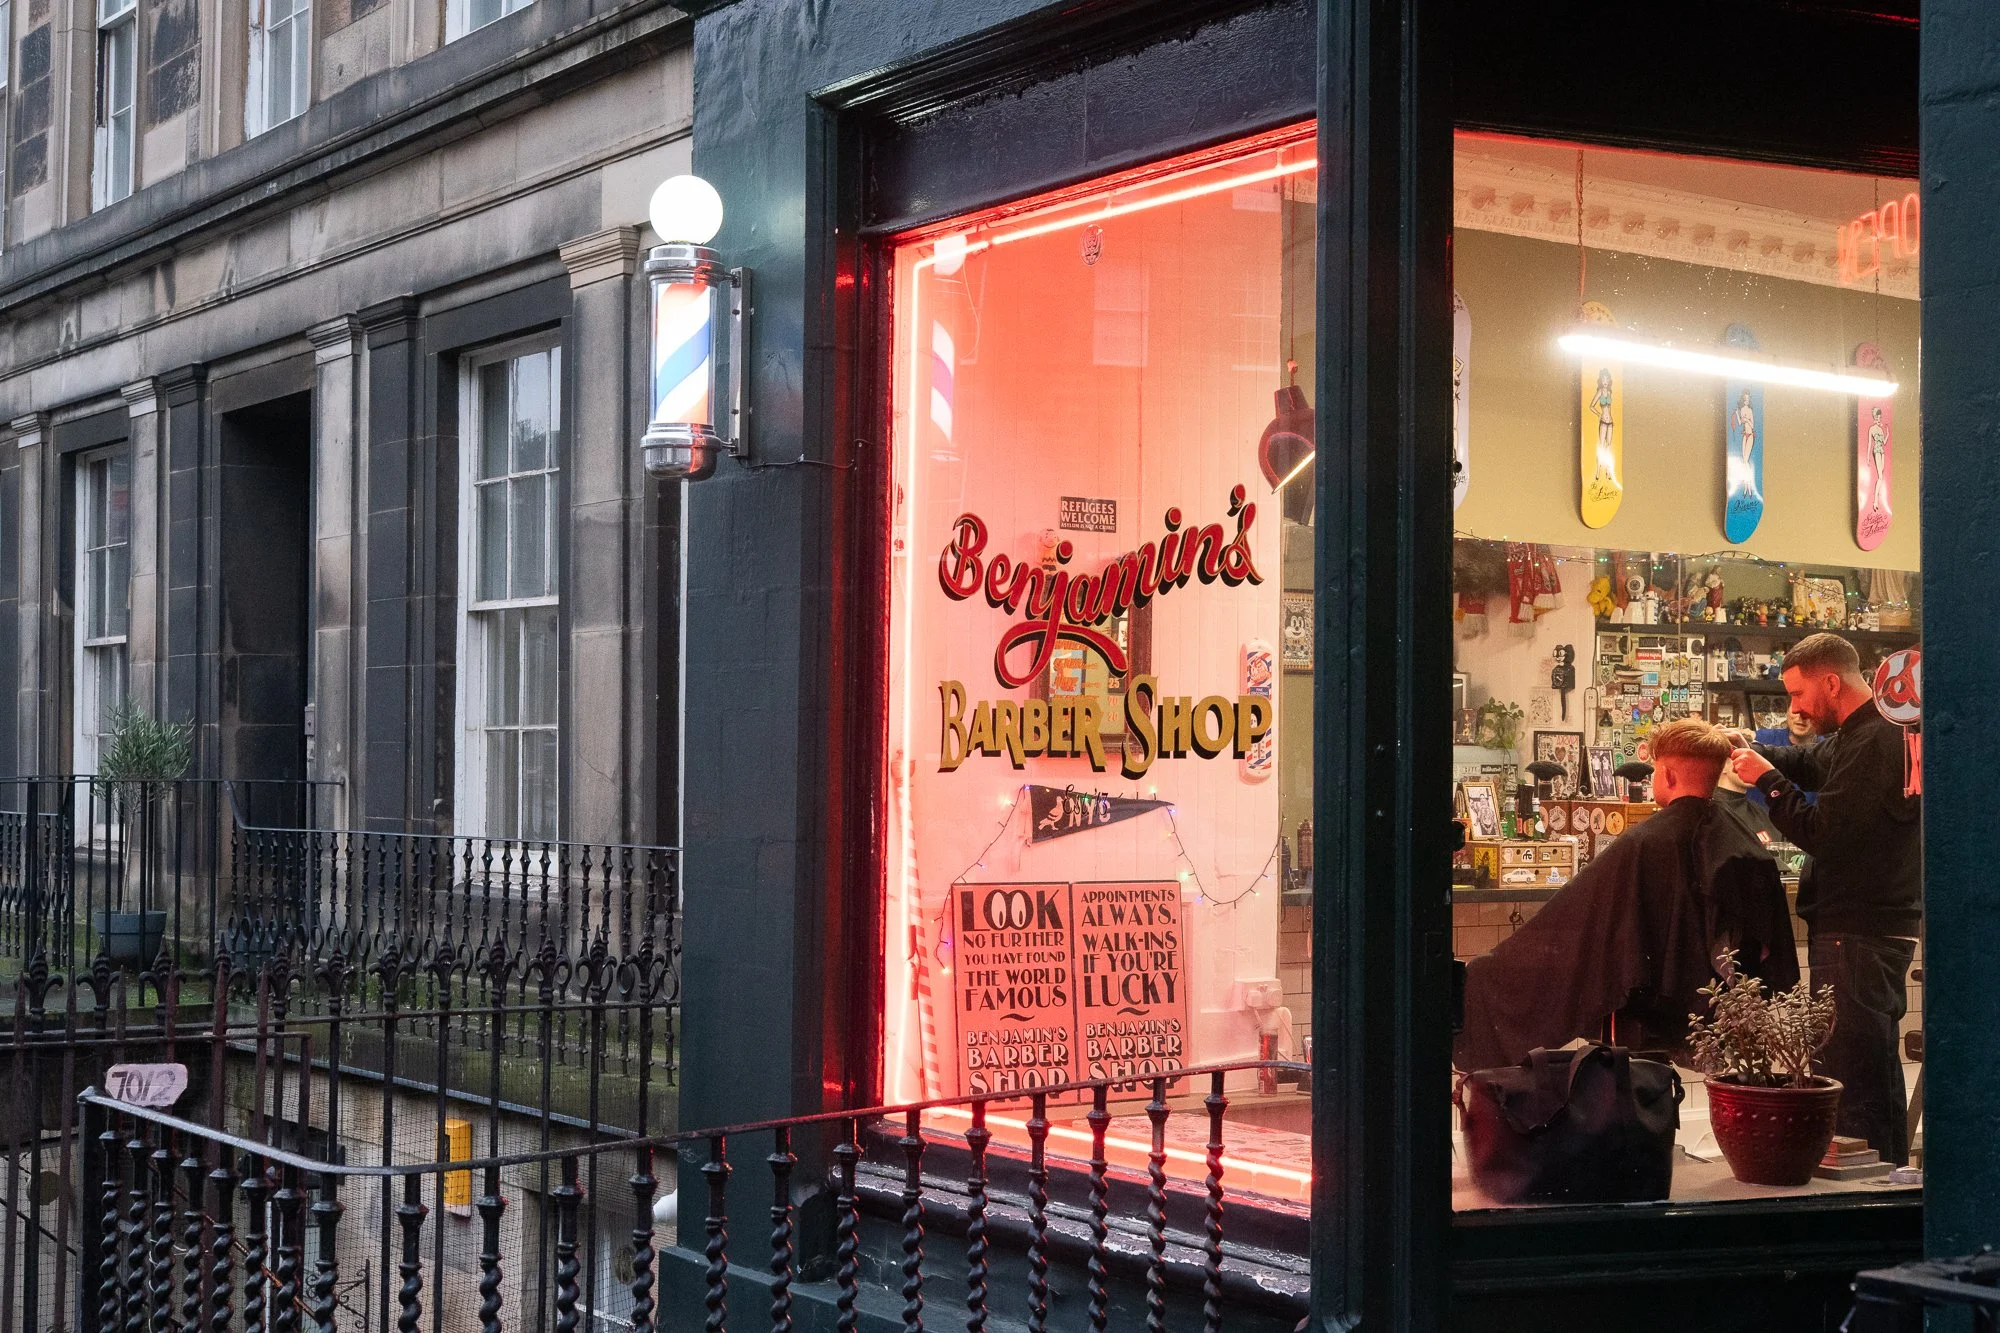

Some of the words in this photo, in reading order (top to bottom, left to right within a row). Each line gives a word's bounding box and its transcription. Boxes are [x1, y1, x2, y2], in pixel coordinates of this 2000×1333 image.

[1060, 511, 1116, 525] WELCOME
[1061, 500, 1115, 514] REFUGEES
[938, 483, 1265, 690] Benjamin's
[1108, 677, 1120, 689] 25
[937, 679, 1108, 774] BARBER
[1120, 673, 1273, 780] SHOP
[1068, 797, 1111, 827] NYC
[1080, 889, 1176, 903] APPOINTMENTS
[961, 889, 1064, 931] LOOK
[1081, 903, 1176, 927] ALWAYS.
[963, 933, 986, 949] NO
[991, 932, 1064, 948] FURTHER
[1082, 930, 1177, 952] WALK-INS
[965, 954, 989, 966] YOU
[992, 953, 1024, 964] HAVE
[1027, 951, 1065, 964] FOUND
[1083, 954, 1101, 973] IF
[1107, 951, 1179, 973] YOU'RE
[964, 970, 1000, 987] THE
[1005, 968, 1066, 986] WORLD
[965, 985, 1067, 1011] FAMOUS
[1084, 972, 1178, 1007] LUCKY
[967, 1026, 1068, 1046] BENJAMIN'S
[1085, 1018, 1181, 1039] BENJAMIN'S
[967, 1043, 1069, 1070] BARBER
[1086, 1034, 1183, 1061] BARBER
[112, 1069, 176, 1102] 70/2
